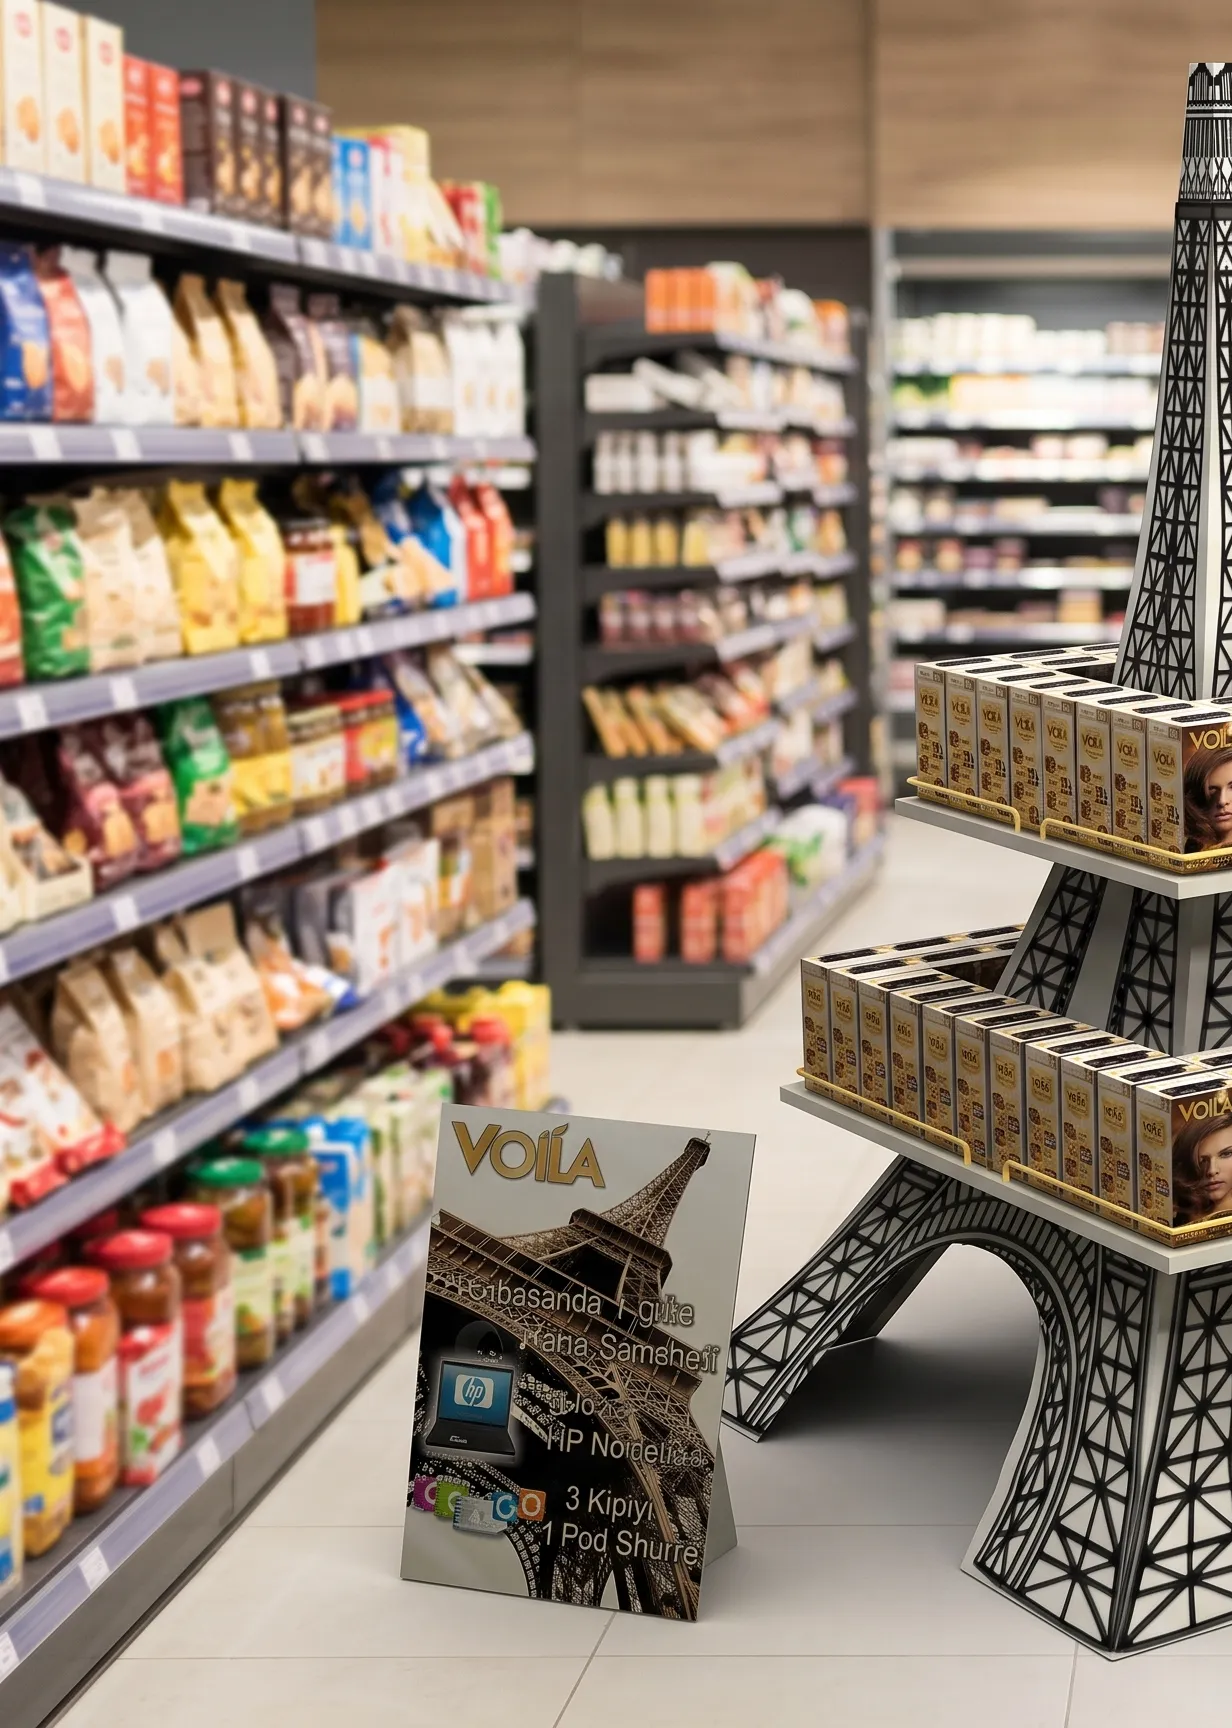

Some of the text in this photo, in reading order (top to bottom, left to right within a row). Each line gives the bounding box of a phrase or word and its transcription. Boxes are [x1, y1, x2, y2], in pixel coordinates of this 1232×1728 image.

[565, 1485, 580, 1511] 3
[542, 1520, 698, 1566] 1 Pod Shurre
